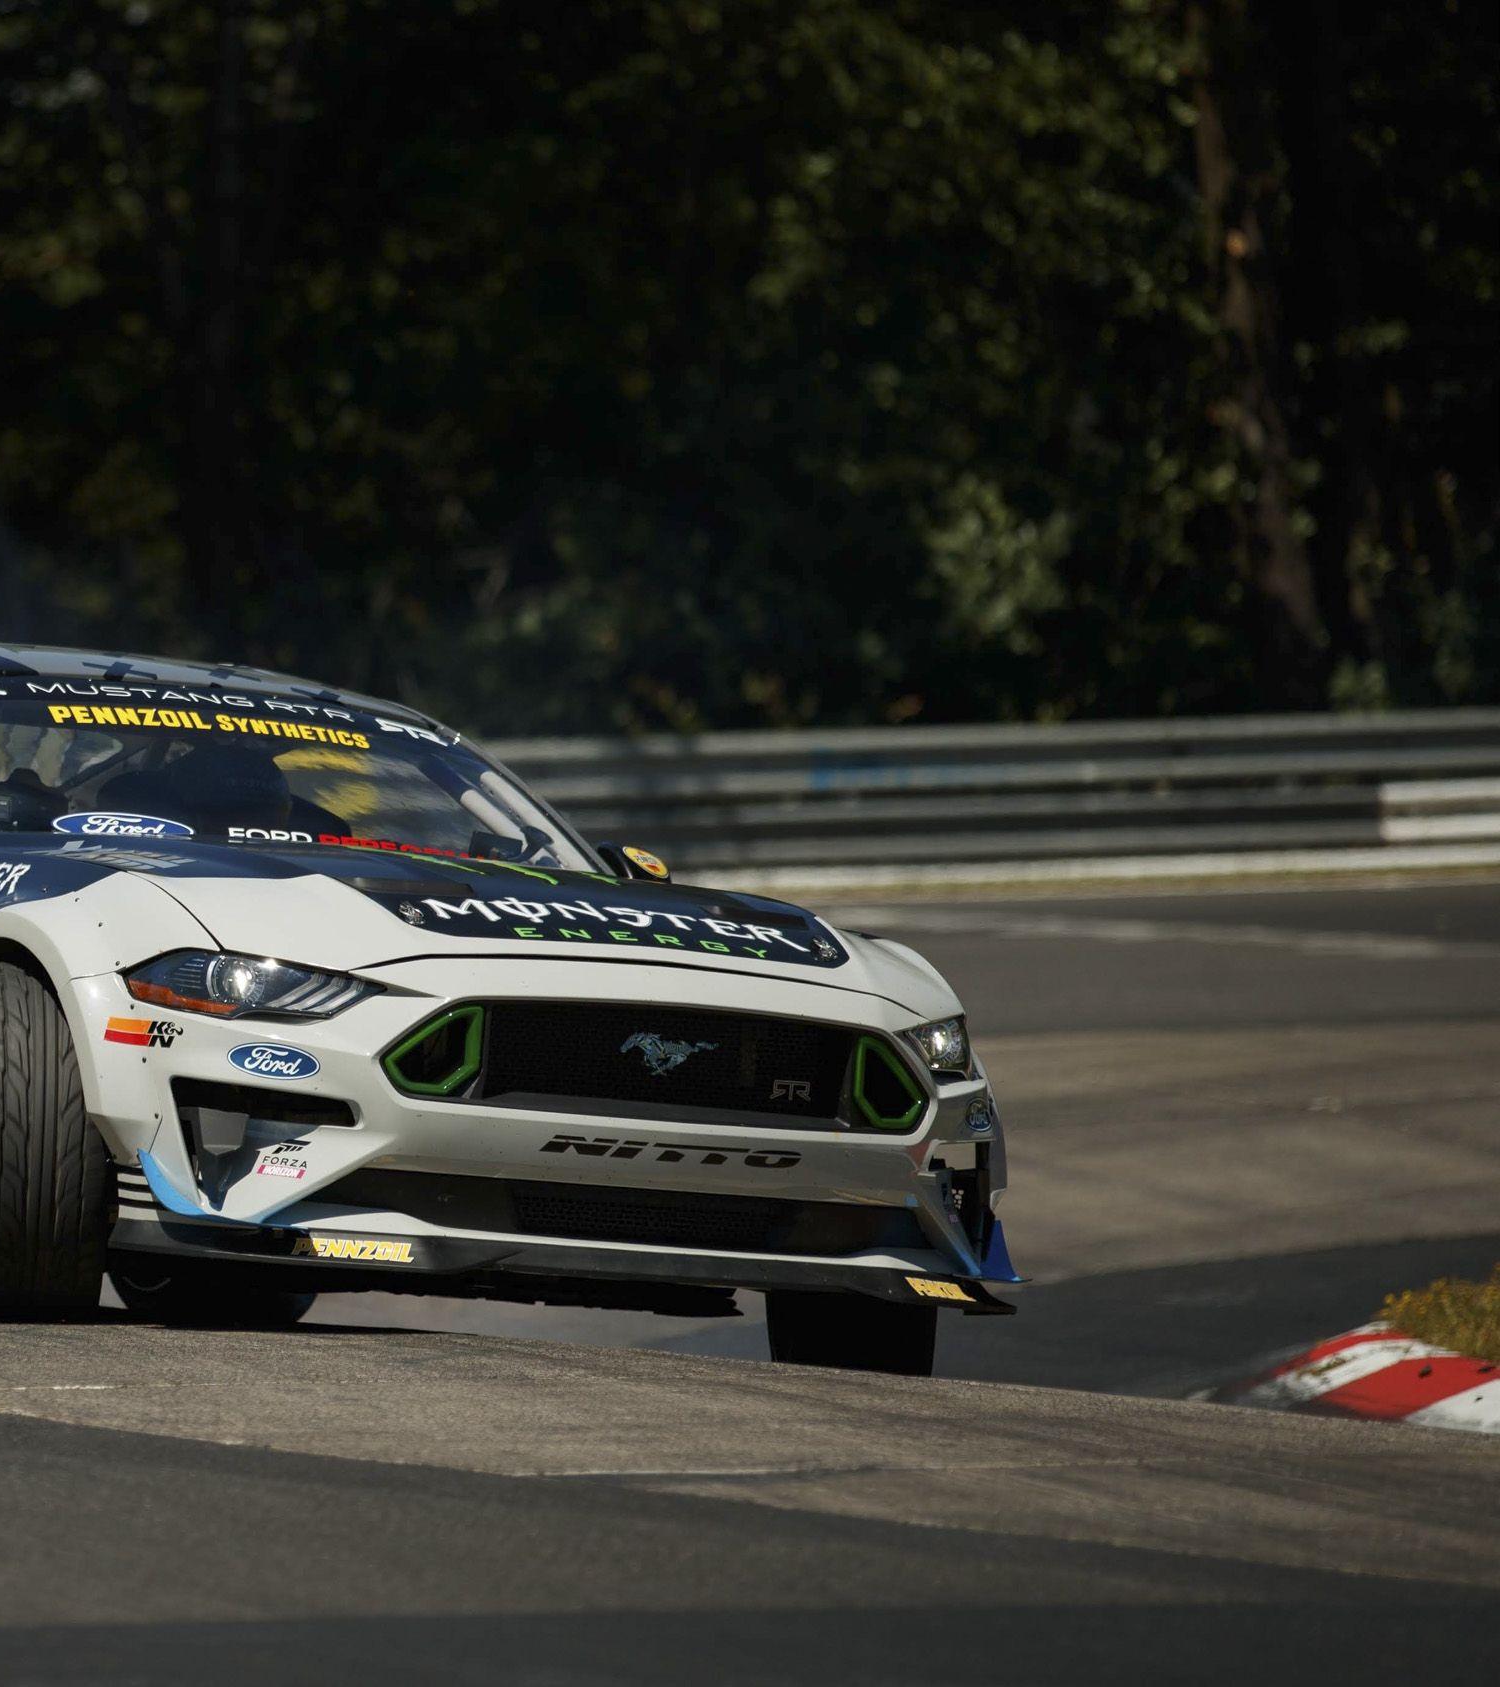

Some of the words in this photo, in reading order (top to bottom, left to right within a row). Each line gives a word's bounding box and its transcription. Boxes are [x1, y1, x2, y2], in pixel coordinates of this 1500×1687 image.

[26, 683, 254, 707] MUSTANG
[264, 699, 355, 722] RTR
[47, 705, 212, 730] PENNZOIL
[214, 714, 370, 749] SYNTHETICS
[513, 927, 769, 959] ENERGY
[243, 1046, 302, 1075] Ford
[262, 1156, 308, 1169] FORZA
[539, 1134, 802, 1168] NITTO
[263, 1165, 298, 1178] HORIZON
[291, 1238, 414, 1263] PENNZOIL
